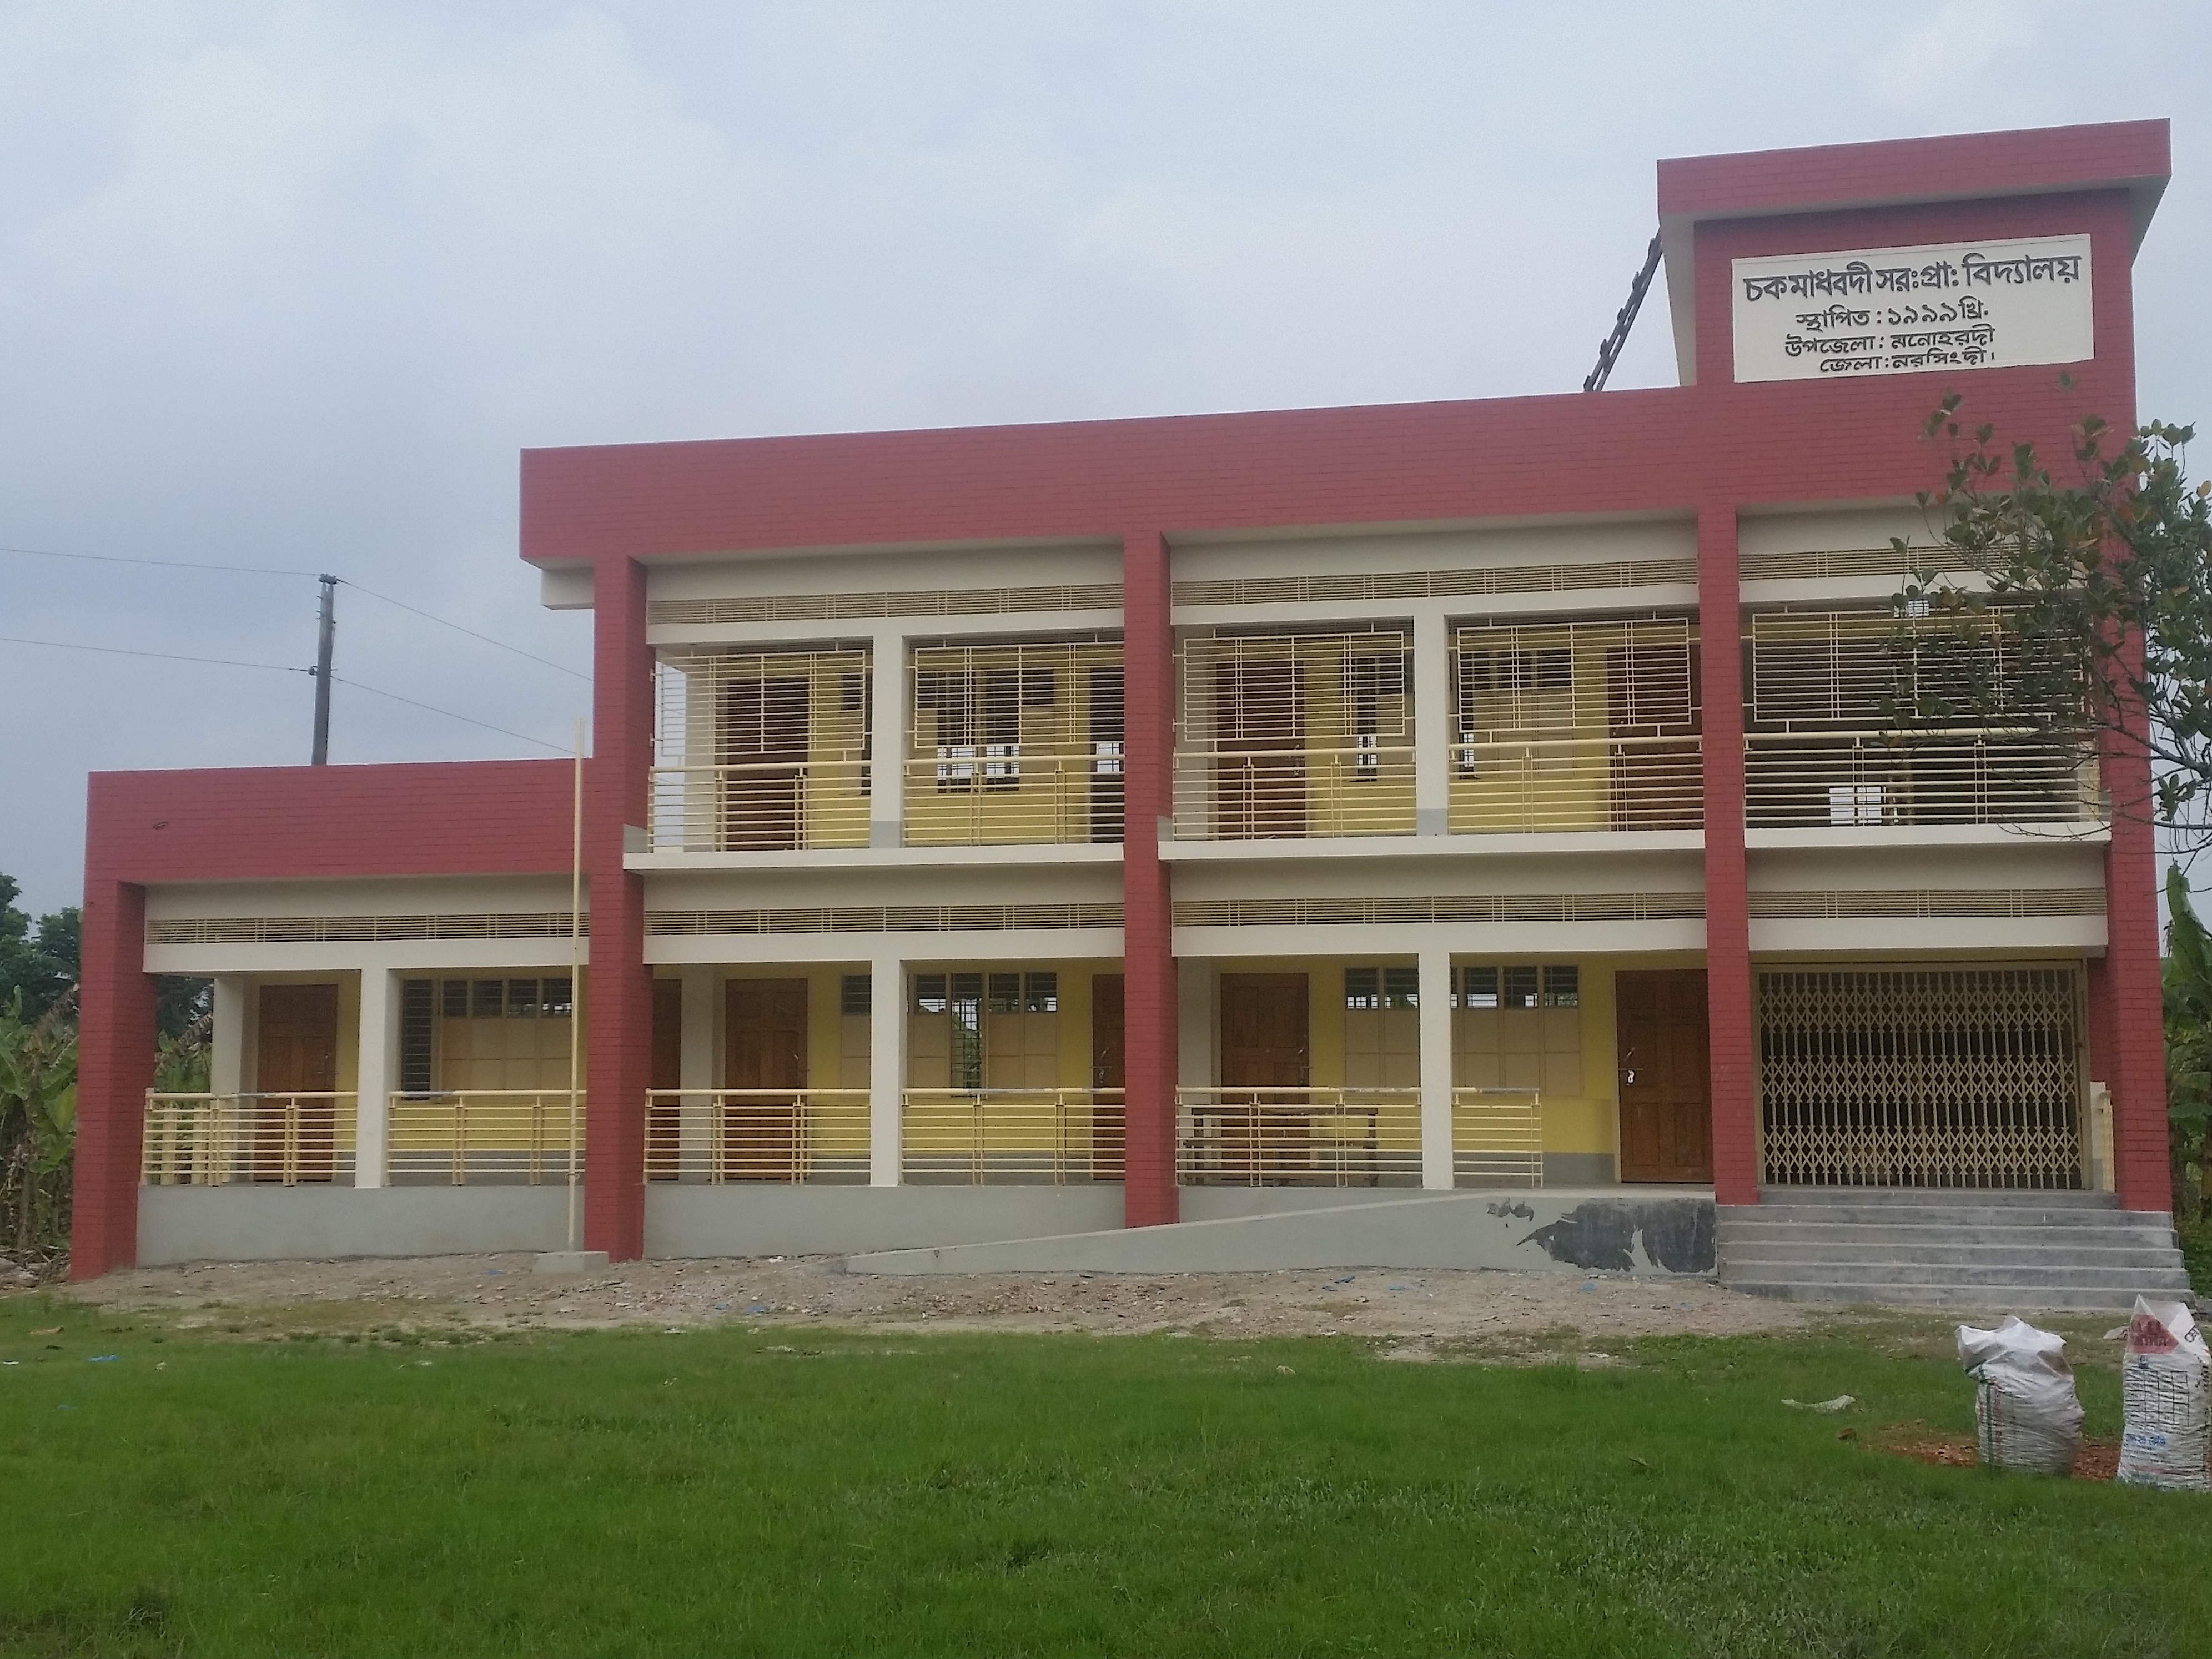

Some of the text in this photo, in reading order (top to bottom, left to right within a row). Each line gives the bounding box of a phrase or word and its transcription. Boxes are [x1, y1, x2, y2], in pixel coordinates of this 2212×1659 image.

[1960, 252, 2082, 286] বিদ্যালয়
[1795, 304, 1871, 332] স্থাপিত
[1890, 323, 1995, 349] মনোহরদী
